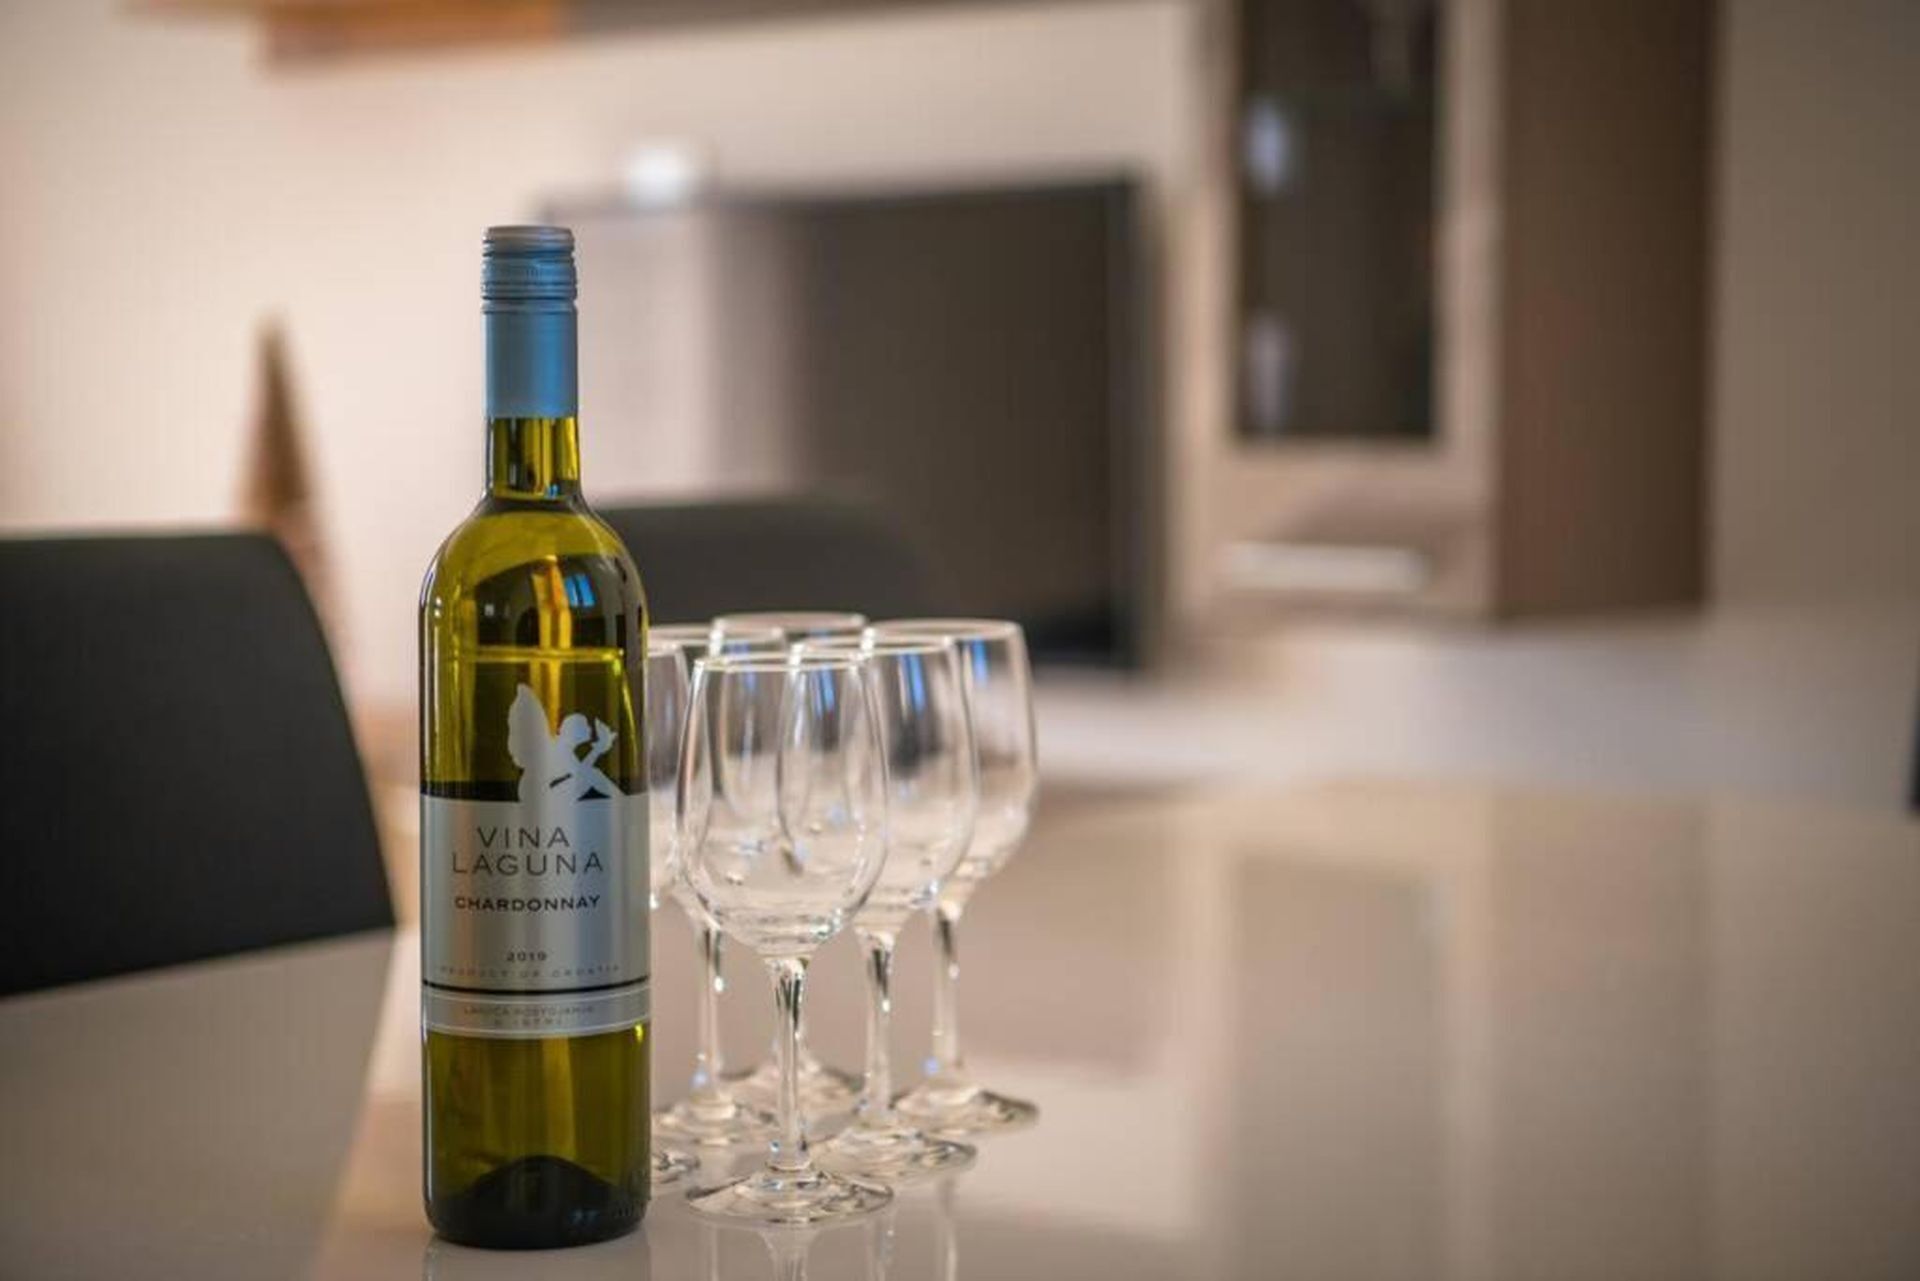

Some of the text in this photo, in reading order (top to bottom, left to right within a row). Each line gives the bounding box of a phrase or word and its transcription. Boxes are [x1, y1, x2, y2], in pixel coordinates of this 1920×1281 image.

[477, 826, 570, 849] VINA
[452, 852, 603, 876] LAGUNA
[454, 895, 601, 912] CHARDONNAY
[507, 950, 547, 962] 2019
